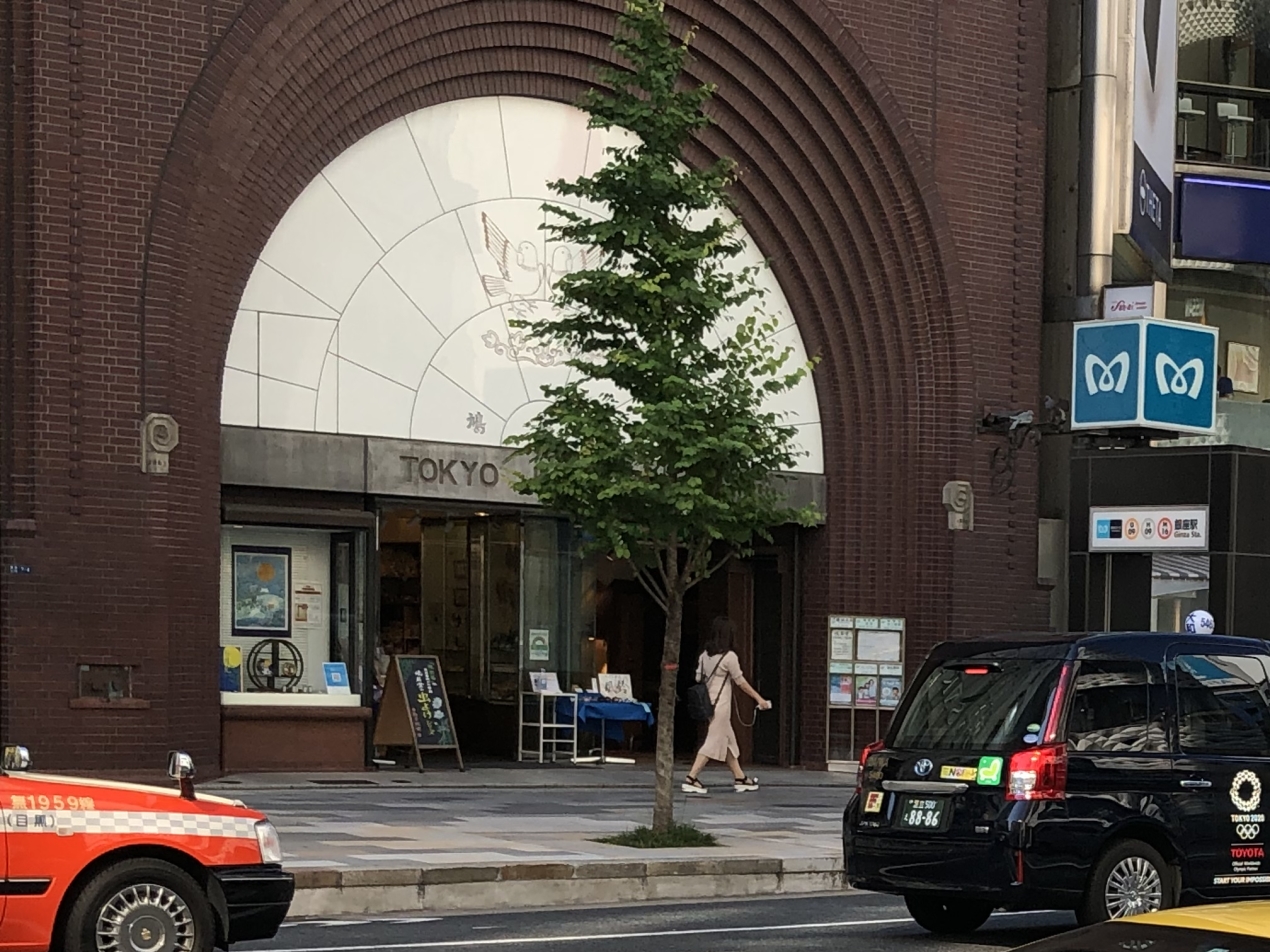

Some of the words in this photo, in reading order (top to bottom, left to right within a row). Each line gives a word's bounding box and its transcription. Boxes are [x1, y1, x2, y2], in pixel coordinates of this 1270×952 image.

[466, 410, 487, 435] 鳩
[399, 455, 499, 488] TOKYO
[1174, 519, 1199, 531] 銀座駅
[908, 810, 941, 827] 88-86
[1230, 814, 1250, 822] TOKYO
[1250, 814, 1266, 822] 2020
[1231, 848, 1265, 858] TOYOTA
